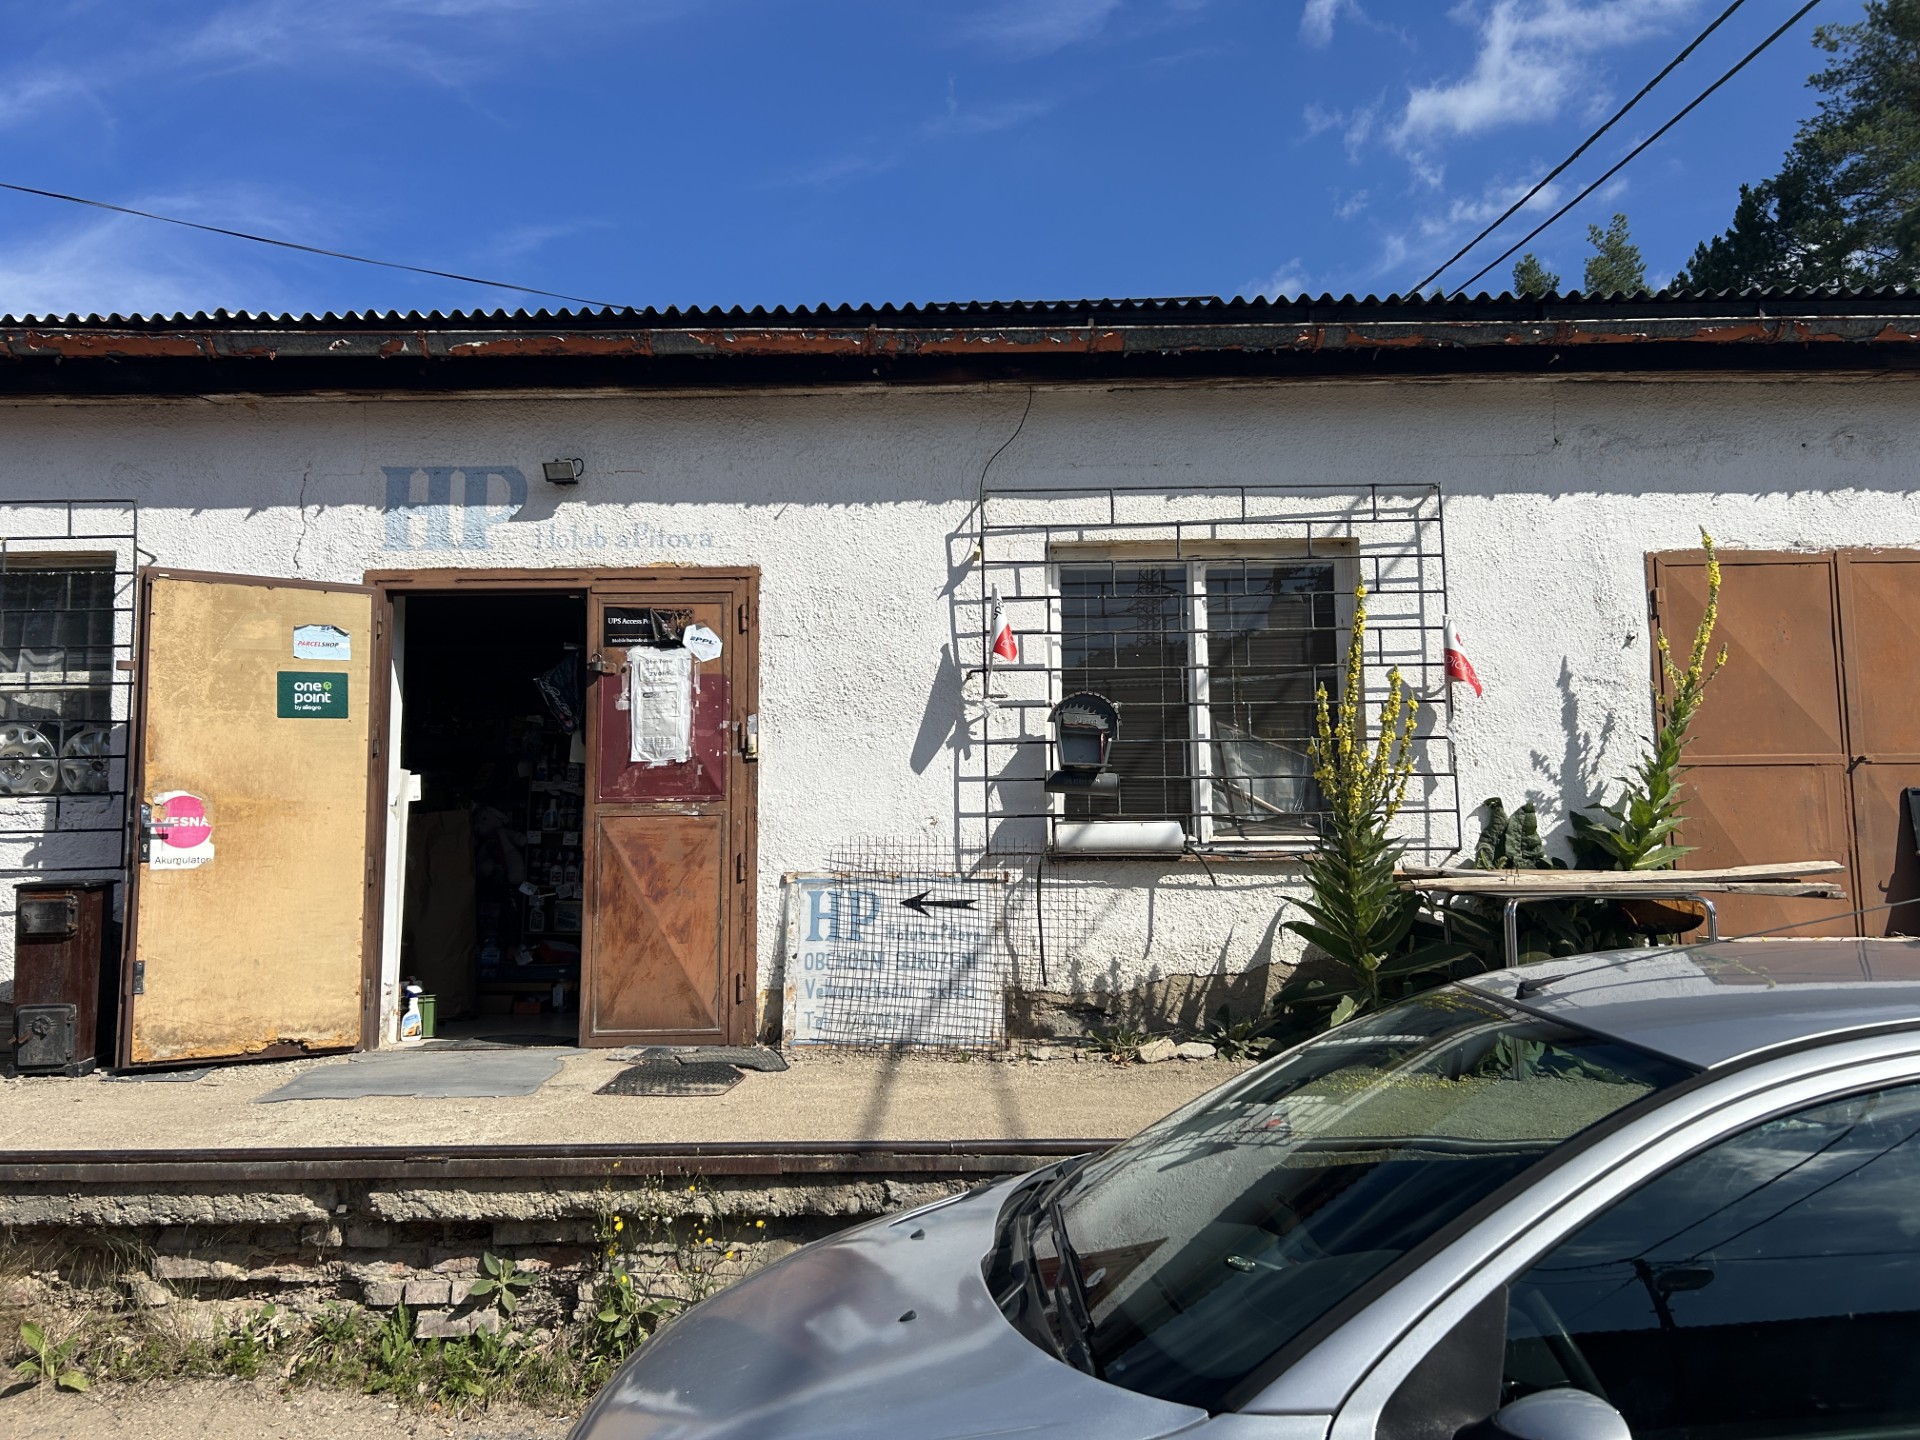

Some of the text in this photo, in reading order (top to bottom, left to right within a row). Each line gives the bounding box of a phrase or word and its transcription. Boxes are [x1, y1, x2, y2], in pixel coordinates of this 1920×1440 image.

[381, 465, 528, 551] HP
[607, 617, 622, 625] UPS
[622, 617, 643, 625] Access
[297, 640, 340, 648] PARCELSHOP
[294, 681, 322, 691] one
[294, 692, 332, 704] point
[805, 890, 882, 942] HP
